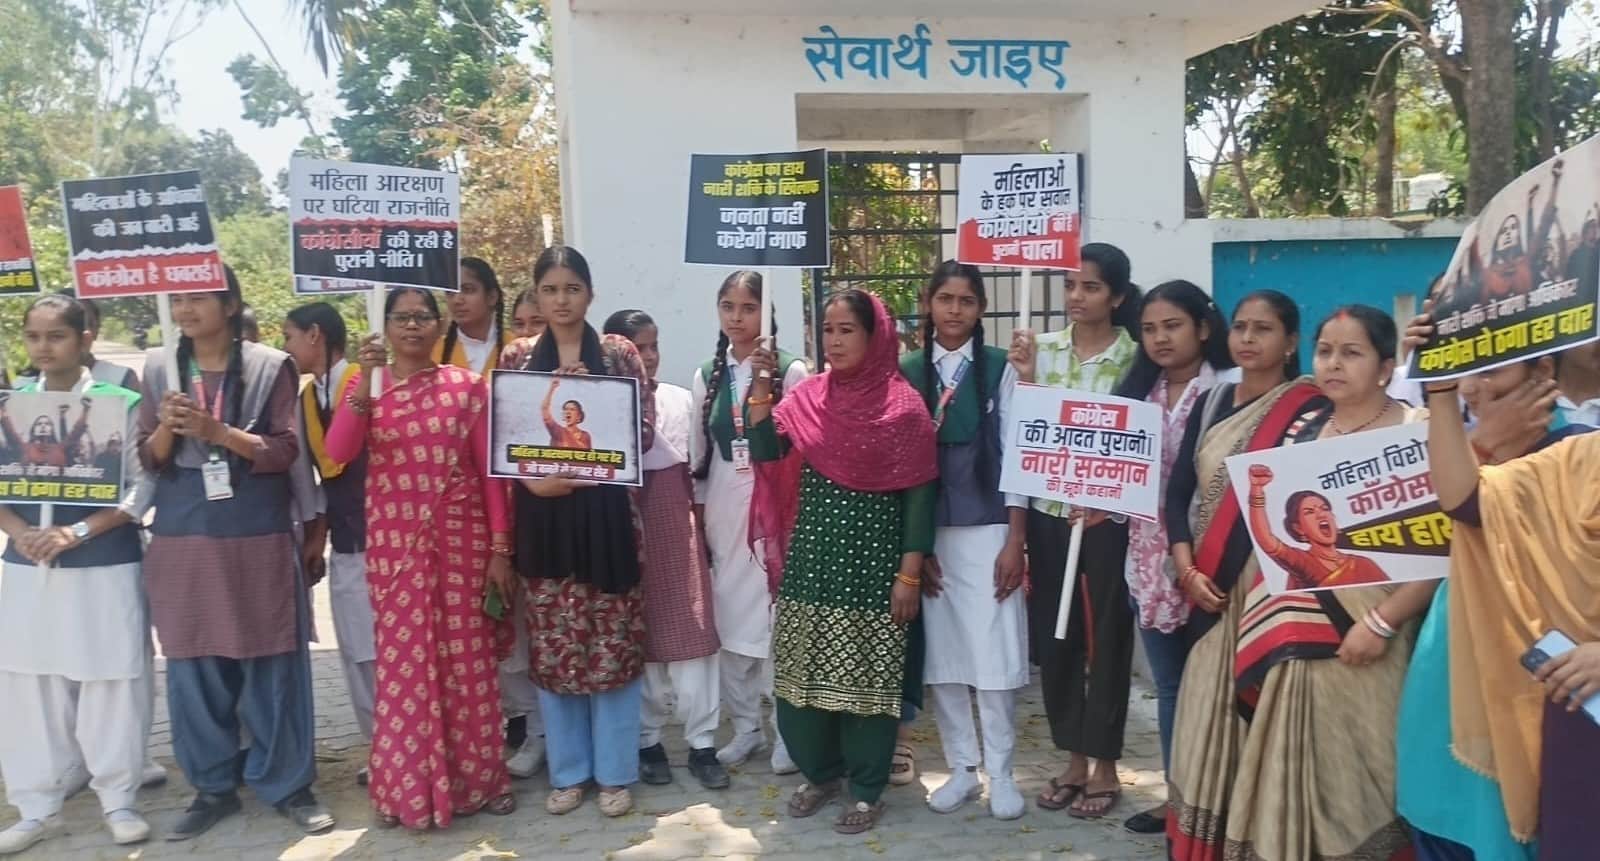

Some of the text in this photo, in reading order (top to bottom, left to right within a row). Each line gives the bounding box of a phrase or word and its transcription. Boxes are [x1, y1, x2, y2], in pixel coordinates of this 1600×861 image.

[802, 23, 1071, 90] सेवार्थ जाइए
[309, 169, 445, 193] महिला आरक्षण
[724, 161, 763, 178] कांग्रेस
[703, 179, 733, 196] नारी
[764, 179, 777, 195] के
[303, 195, 450, 217] पर घटिया राजनीति
[980, 191, 994, 210] के
[997, 194, 1016, 210] हक
[1019, 192, 1037, 208] पर
[719, 201, 806, 225] जनता नहीं
[387, 231, 409, 248] की
[415, 231, 438, 249] रही
[443, 231, 454, 249] है
[716, 226, 808, 249] करेगी माफ
[334, 250, 376, 272] पुरानी
[84, 263, 145, 287] कांग्रेस
[148, 261, 159, 284] है
[1420, 338, 1475, 370] कांग्रेस
[1476, 327, 1493, 357] ने
[1495, 322, 1528, 354] ठगा
[1530, 314, 1556, 344] हर
[1071, 404, 1119, 427] कांग्रेस
[1024, 420, 1049, 443] की
[1053, 426, 1096, 448] आदत
[1021, 447, 1149, 486] नारी सम्मान
[1318, 438, 1428, 490] महिला विरो
[1046, 477, 1061, 492] की
[1087, 484, 1122, 499] कहानी
[1346, 521, 1405, 547] हाय
